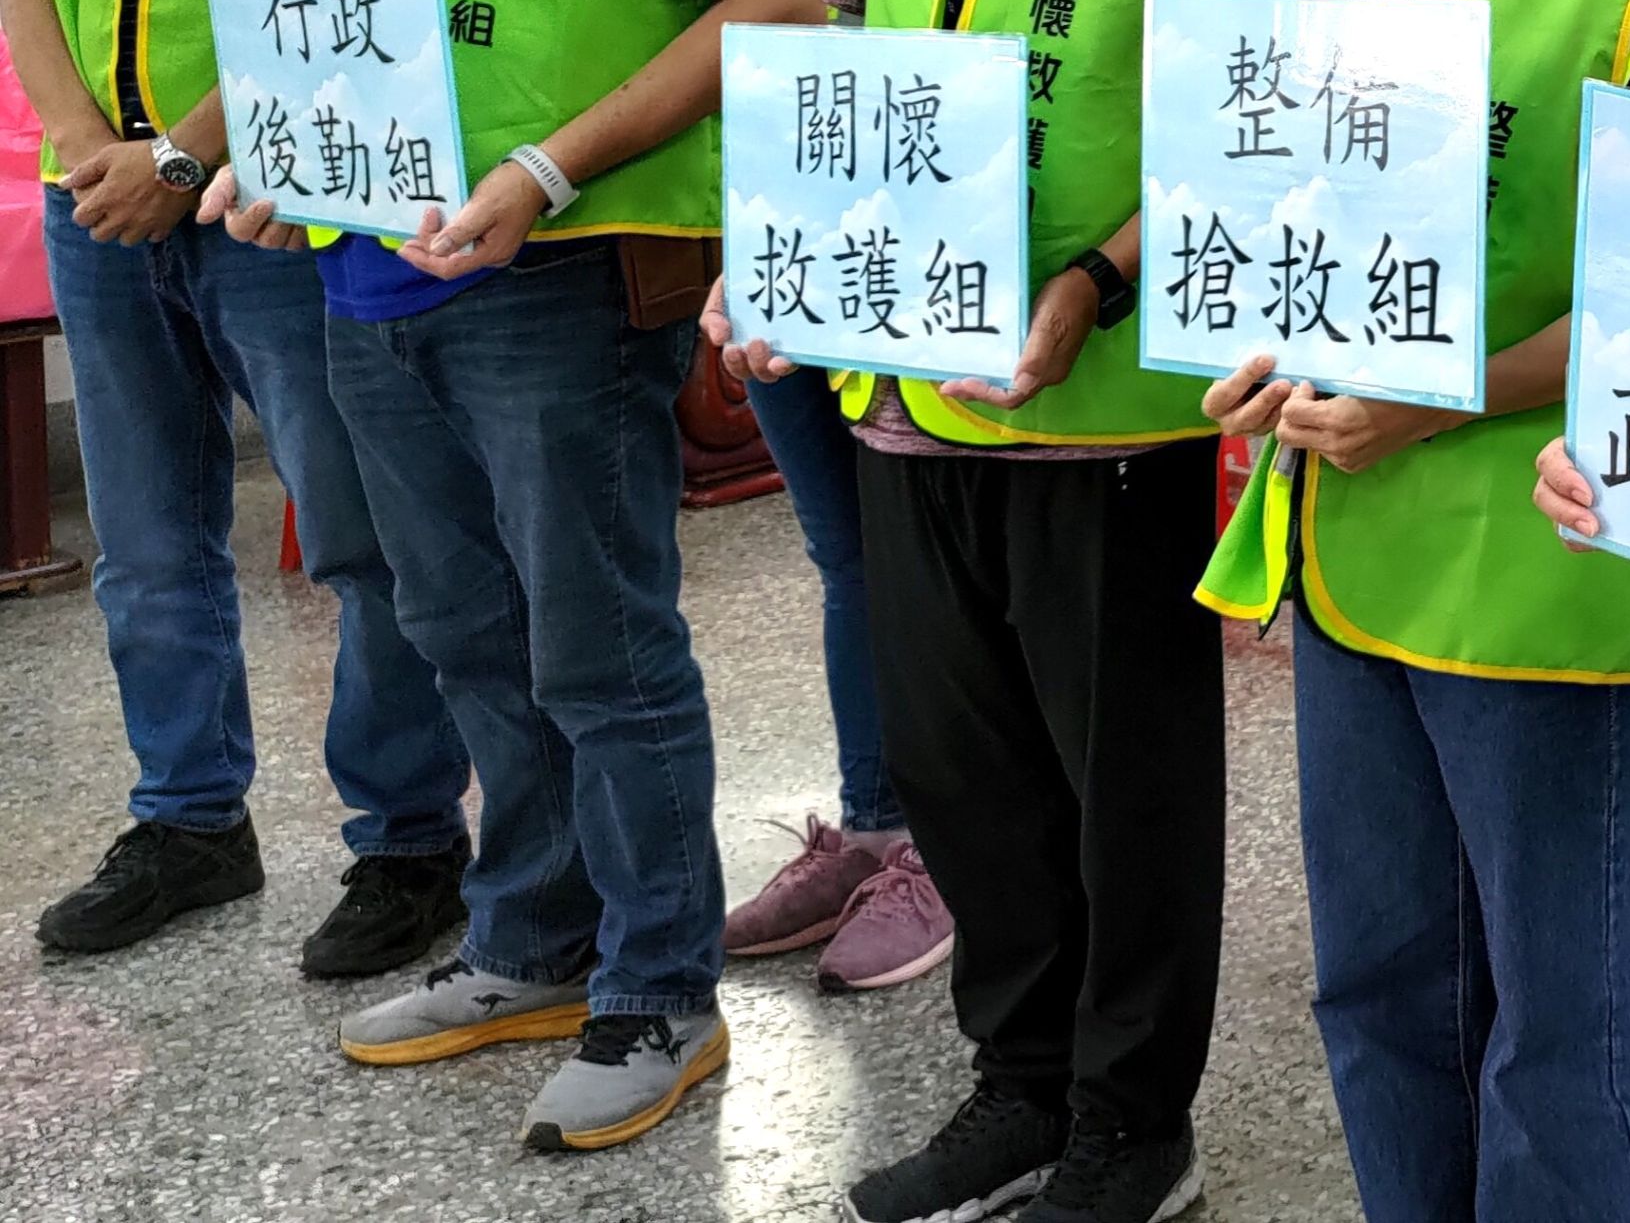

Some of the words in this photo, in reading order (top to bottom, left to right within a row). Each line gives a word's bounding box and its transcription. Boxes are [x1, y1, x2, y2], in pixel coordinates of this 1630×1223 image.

[247, 97, 447, 206] 後勤組
[795, 69, 953, 186] 關懷
[1220, 34, 1398, 169] 整備
[747, 223, 1001, 340] 救護組
[1165, 212, 1455, 347] 搶救組
